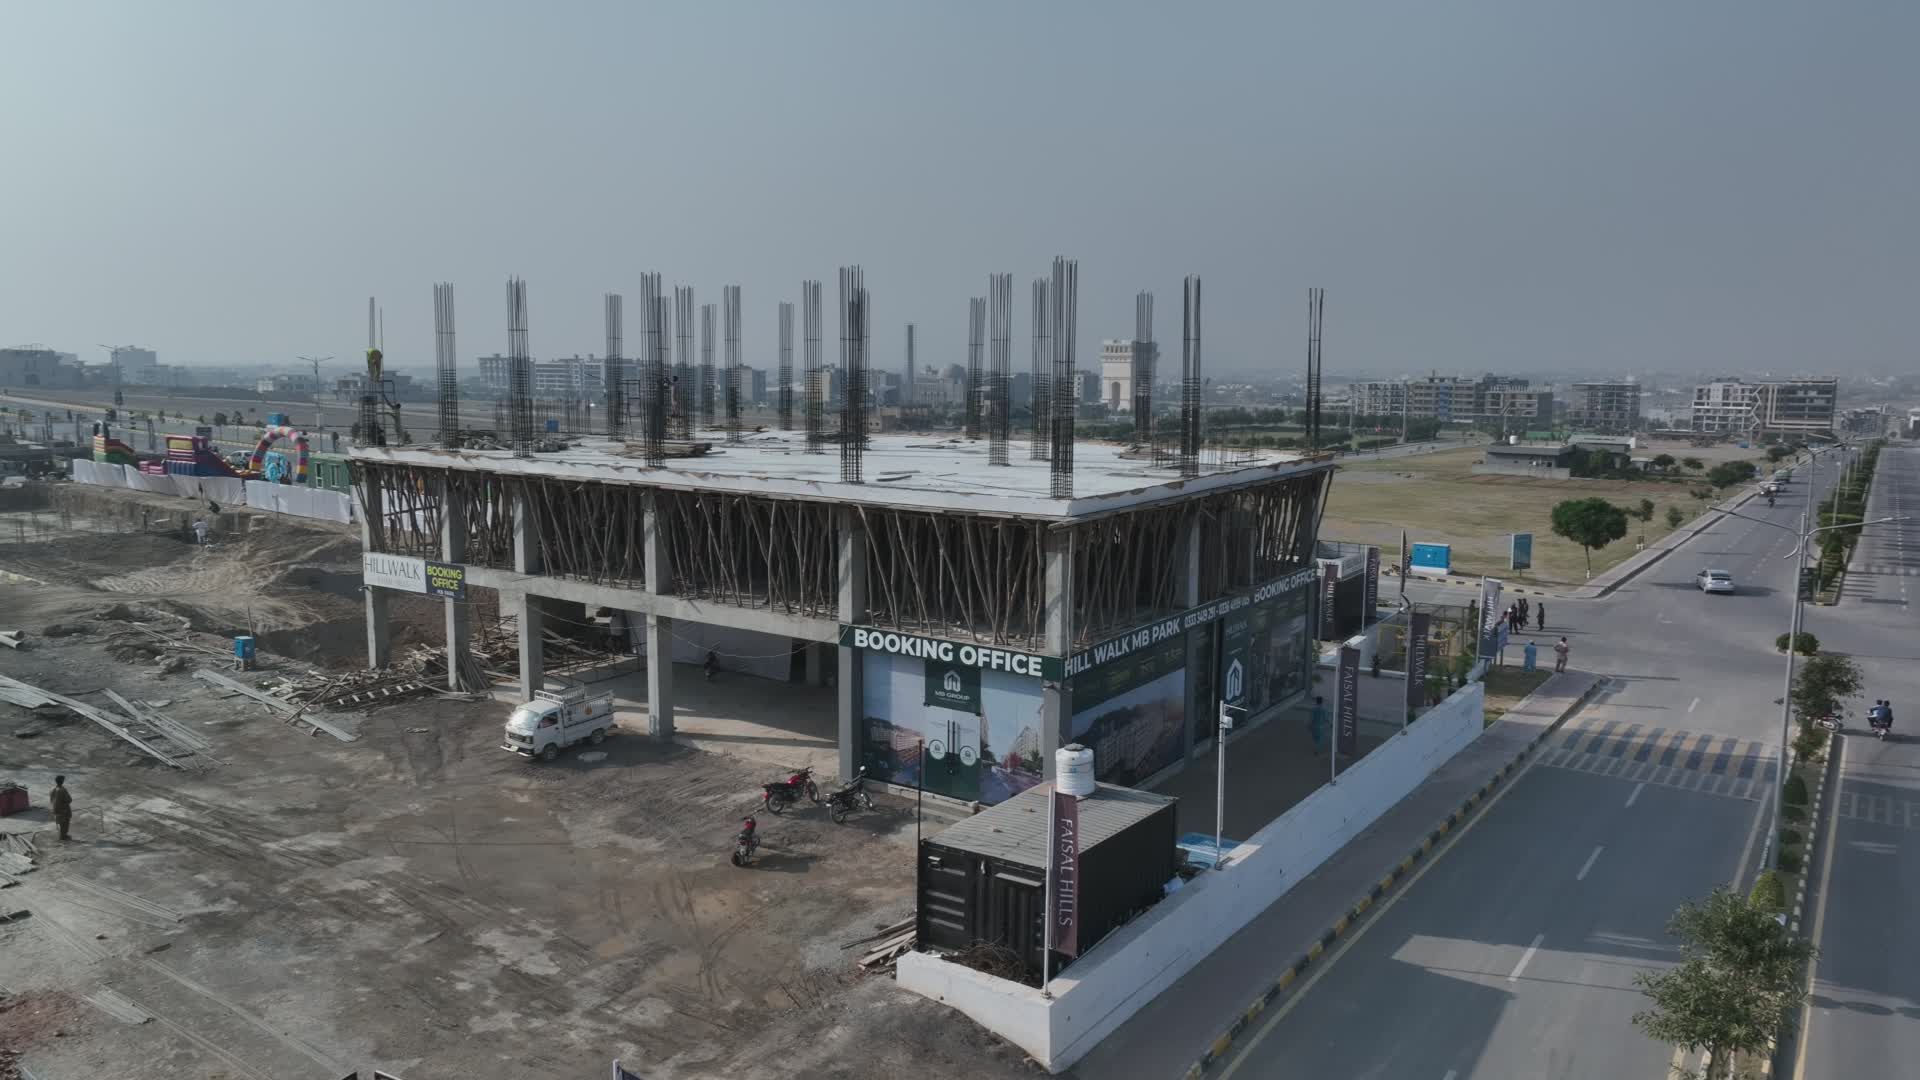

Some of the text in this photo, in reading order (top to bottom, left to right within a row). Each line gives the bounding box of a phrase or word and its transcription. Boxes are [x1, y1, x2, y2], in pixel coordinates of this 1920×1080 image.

[365, 556, 420, 580] HILLWALK
[427, 565, 462, 579] BOOKING
[432, 577, 459, 590] OFFICE
[1064, 652, 1092, 678] HILL
[1094, 637, 1130, 665] WALK
[1132, 627, 1150, 649] MB
[1152, 618, 1181, 646] PARK
[1254, 578, 1290, 604] BOOKING
[1290, 568, 1316, 591] OFFICE
[854, 628, 1043, 677] BOOKING OFFICE
[1415, 634, 1425, 688] HILLWALK
[1343, 666, 1354, 737] FAISAL HILLS
[1059, 818, 1074, 926] FAISAL HILLS
